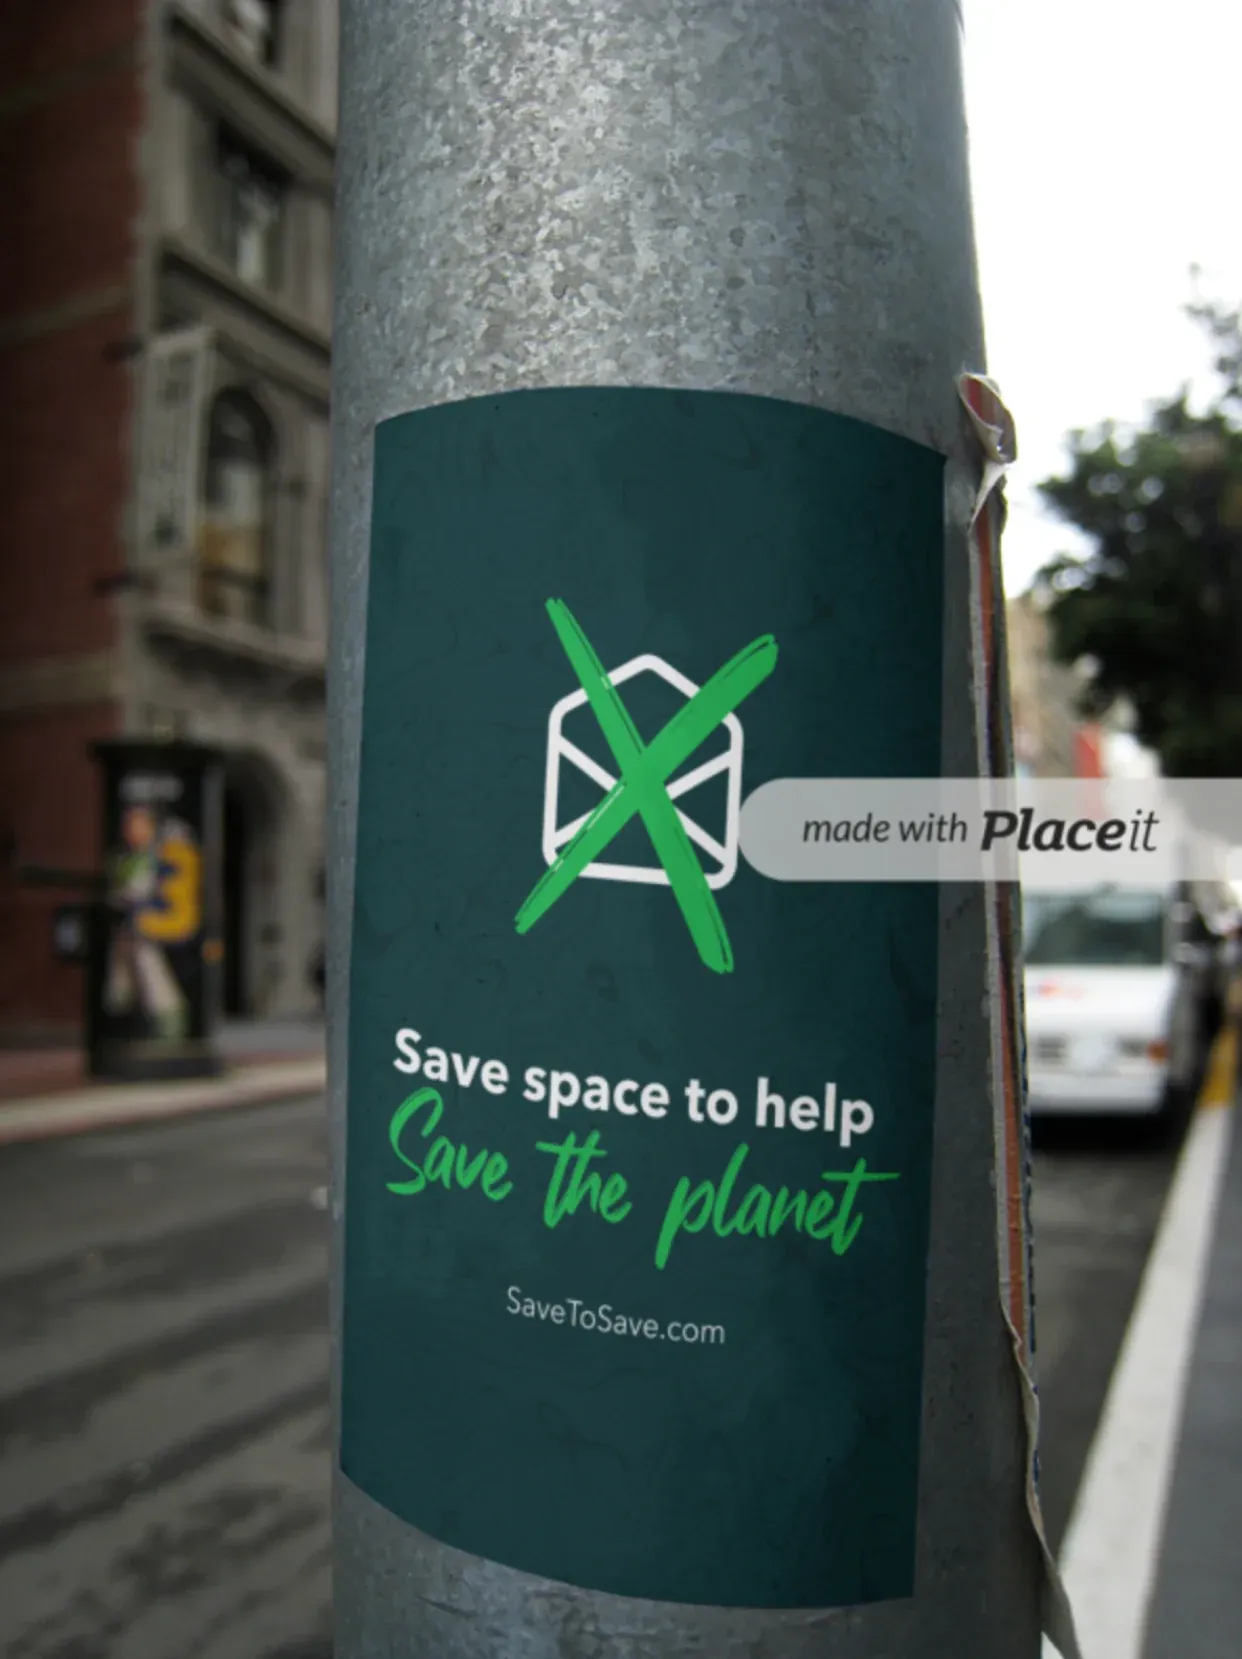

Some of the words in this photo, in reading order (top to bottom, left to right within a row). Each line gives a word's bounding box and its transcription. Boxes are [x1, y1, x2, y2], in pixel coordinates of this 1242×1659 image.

[393, 1027, 509, 1095] Save
[522, 1066, 670, 1119] space
[684, 1078, 738, 1125] to
[755, 1077, 874, 1147] help
[386, 1087, 513, 1201] Save
[535, 1130, 632, 1229] the
[655, 1143, 900, 1270] planet
[506, 1285, 725, 1344] SaveToSave.com
